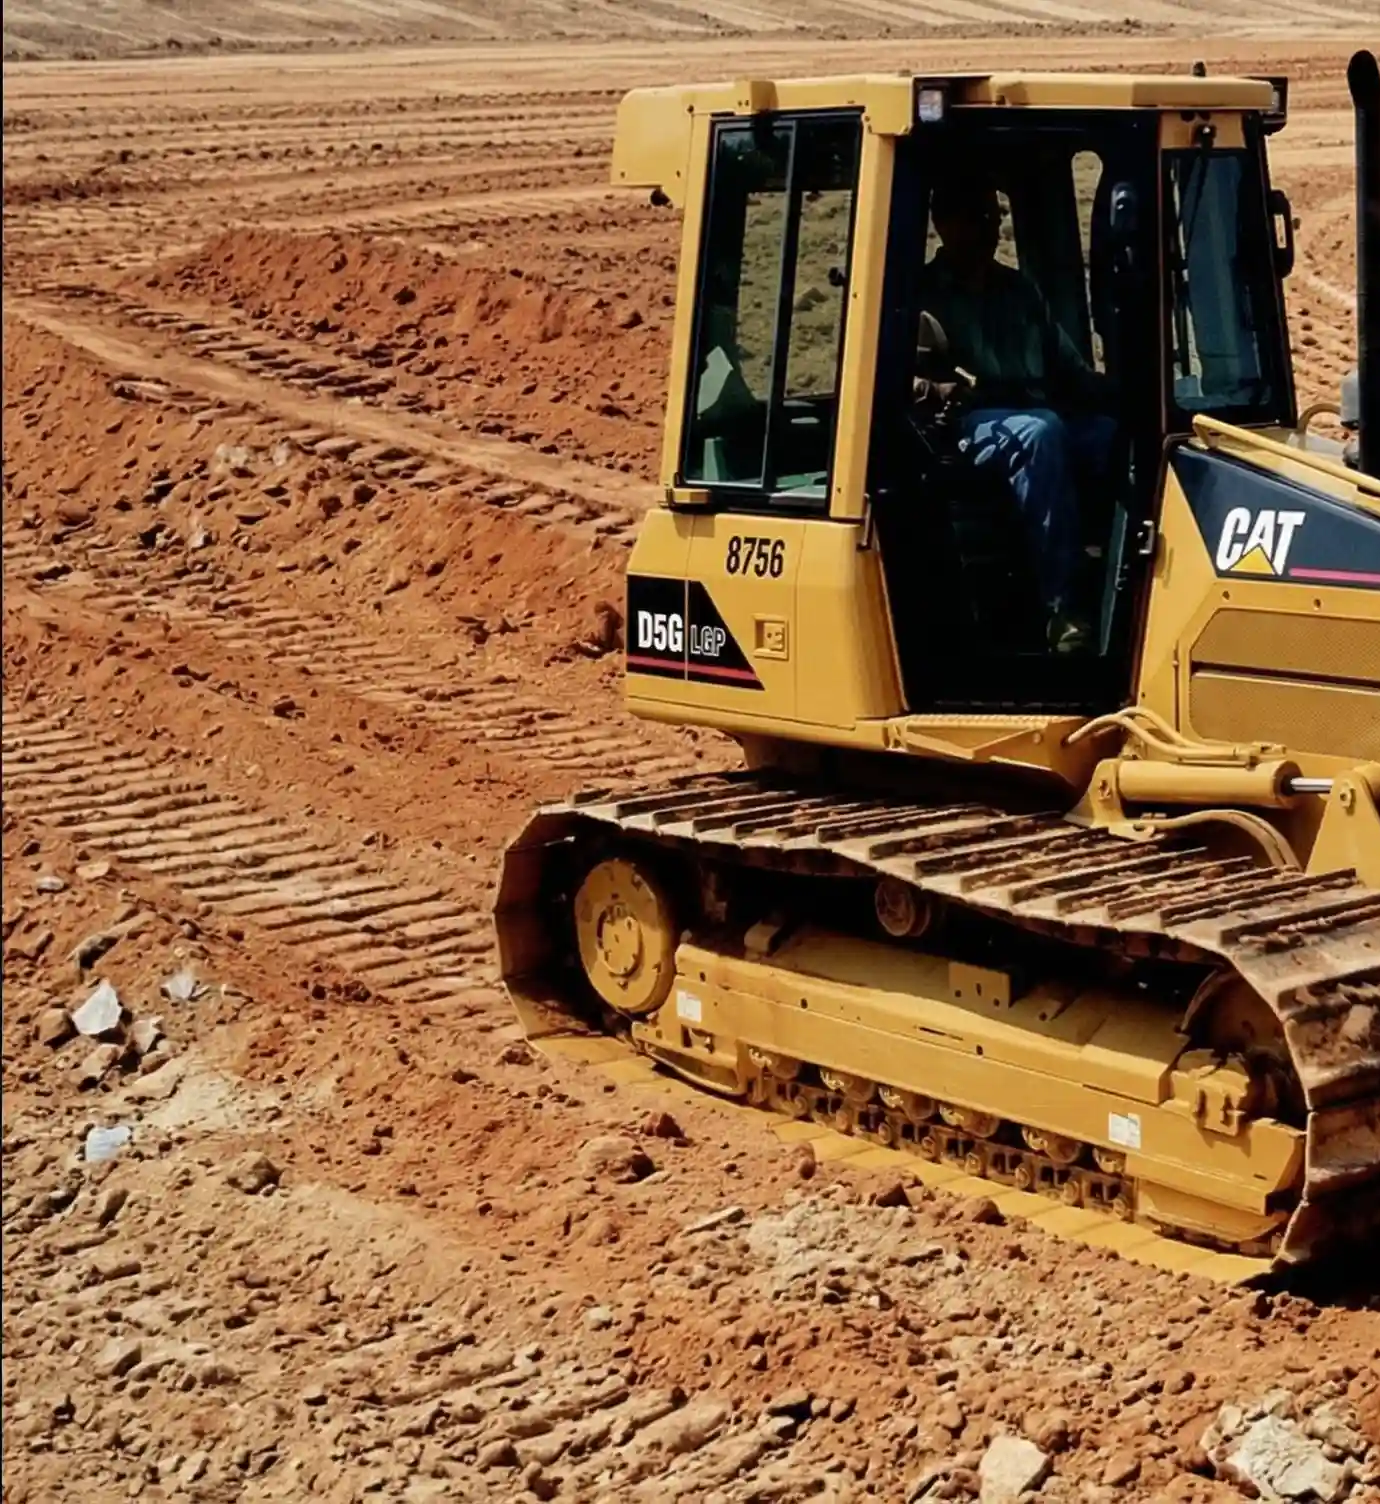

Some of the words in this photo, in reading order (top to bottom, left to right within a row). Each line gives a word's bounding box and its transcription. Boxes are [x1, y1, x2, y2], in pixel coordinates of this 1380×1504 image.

[726, 536, 785, 578] 8756
[1216, 507, 1306, 576] CAT
[637, 610, 684, 652] D5G
[690, 624, 726, 657] LGP
